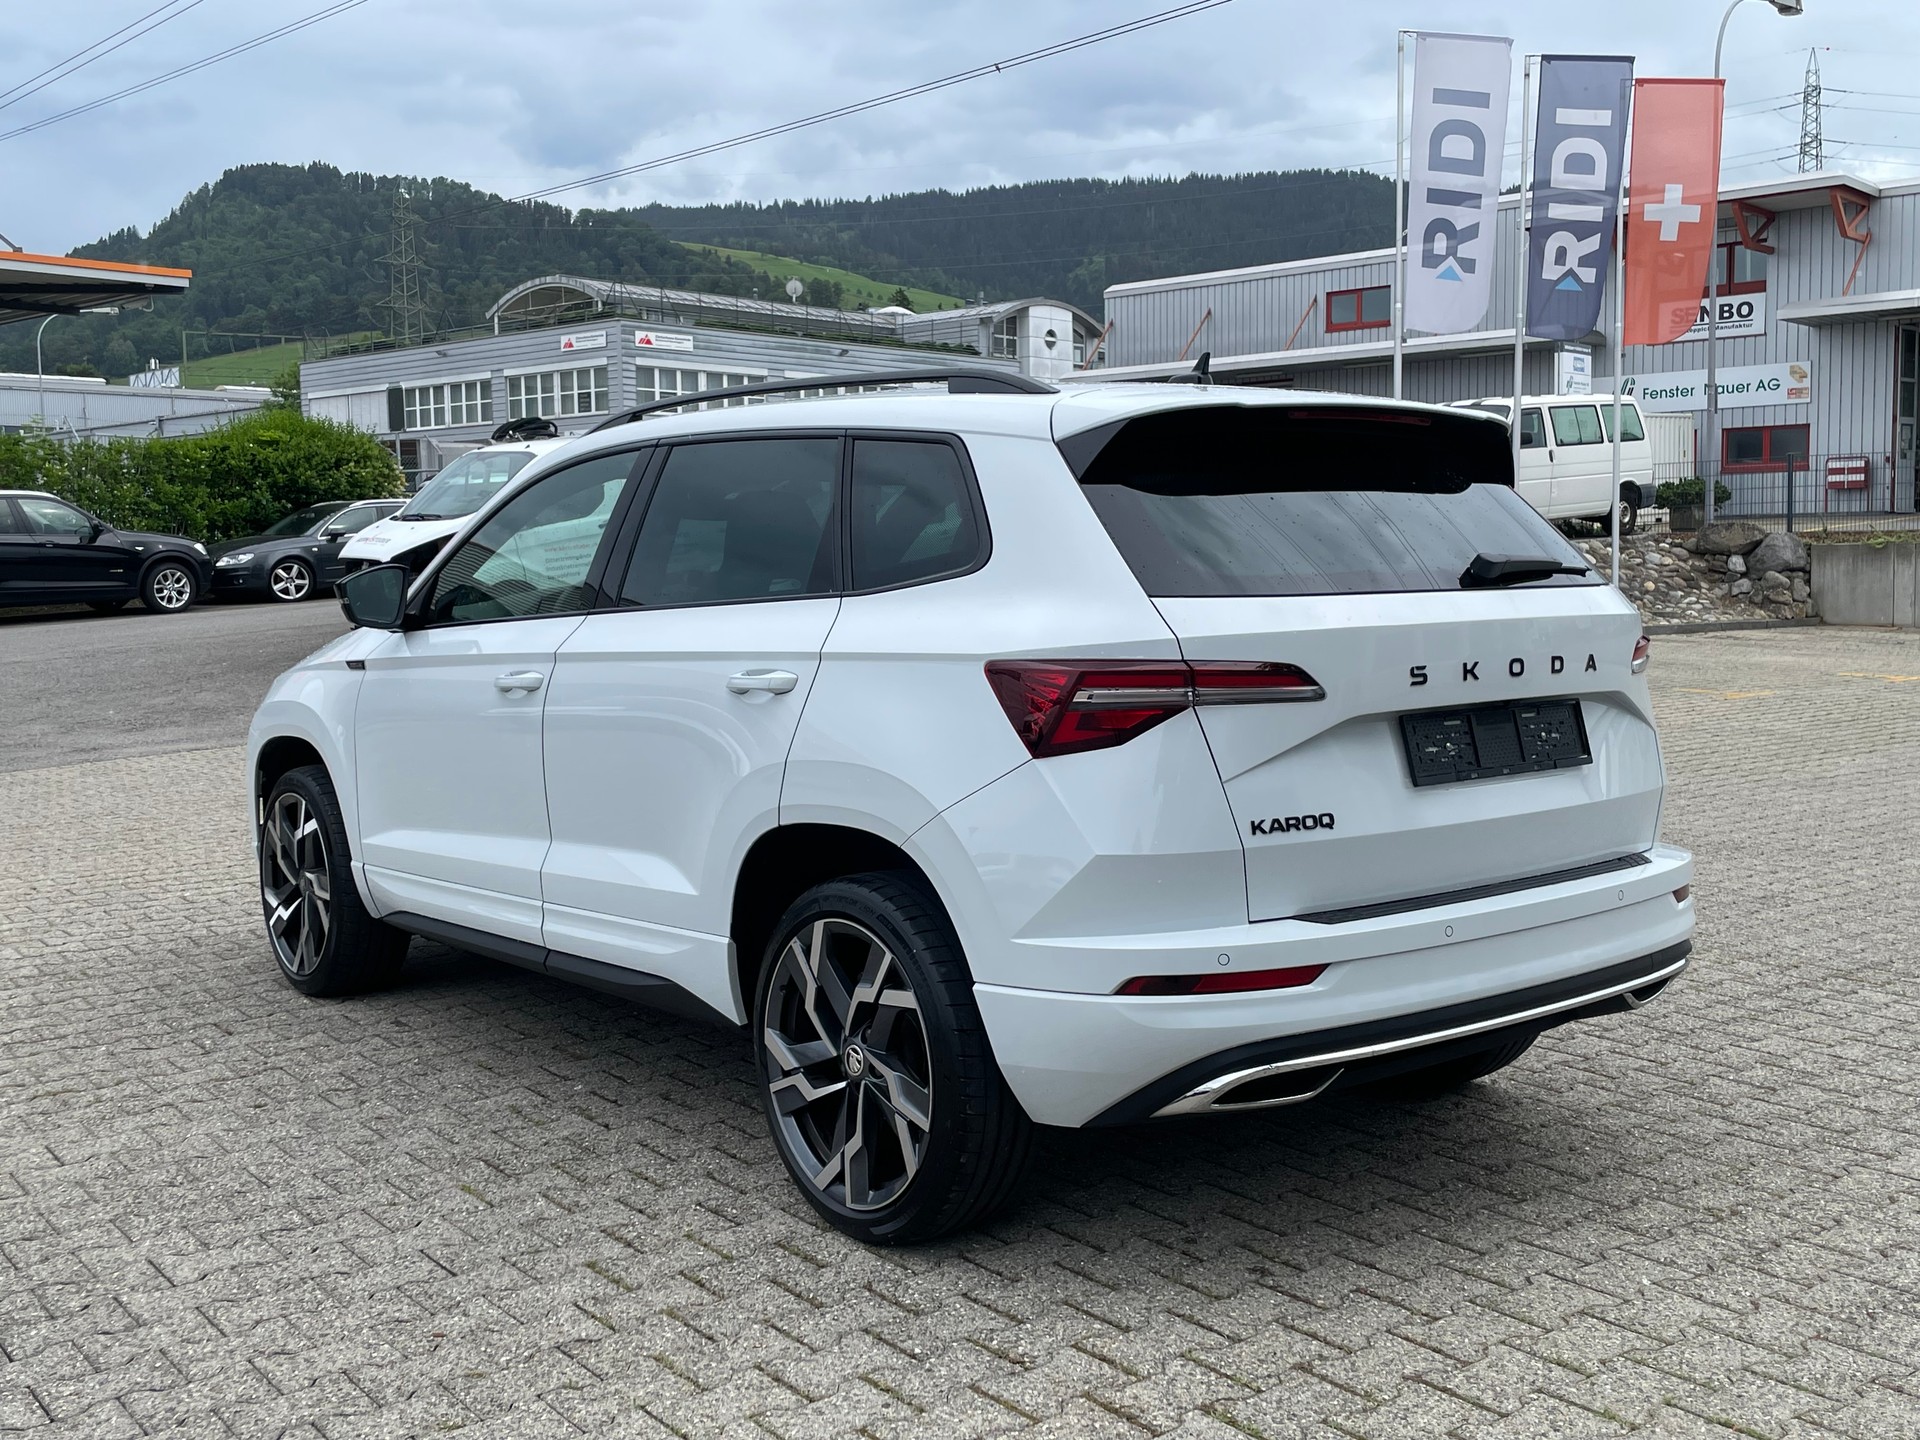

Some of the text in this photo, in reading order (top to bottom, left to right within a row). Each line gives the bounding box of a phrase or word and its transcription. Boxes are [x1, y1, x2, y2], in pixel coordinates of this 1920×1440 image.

[1421, 87, 1491, 275] RIDI
[1541, 107, 1612, 284] RIDI
[1642, 385, 1696, 400] Fenster
[1755, 377, 1781, 392] AG
[1409, 653, 1598, 687] SKODA
[1250, 812, 1336, 836] KAROQ
